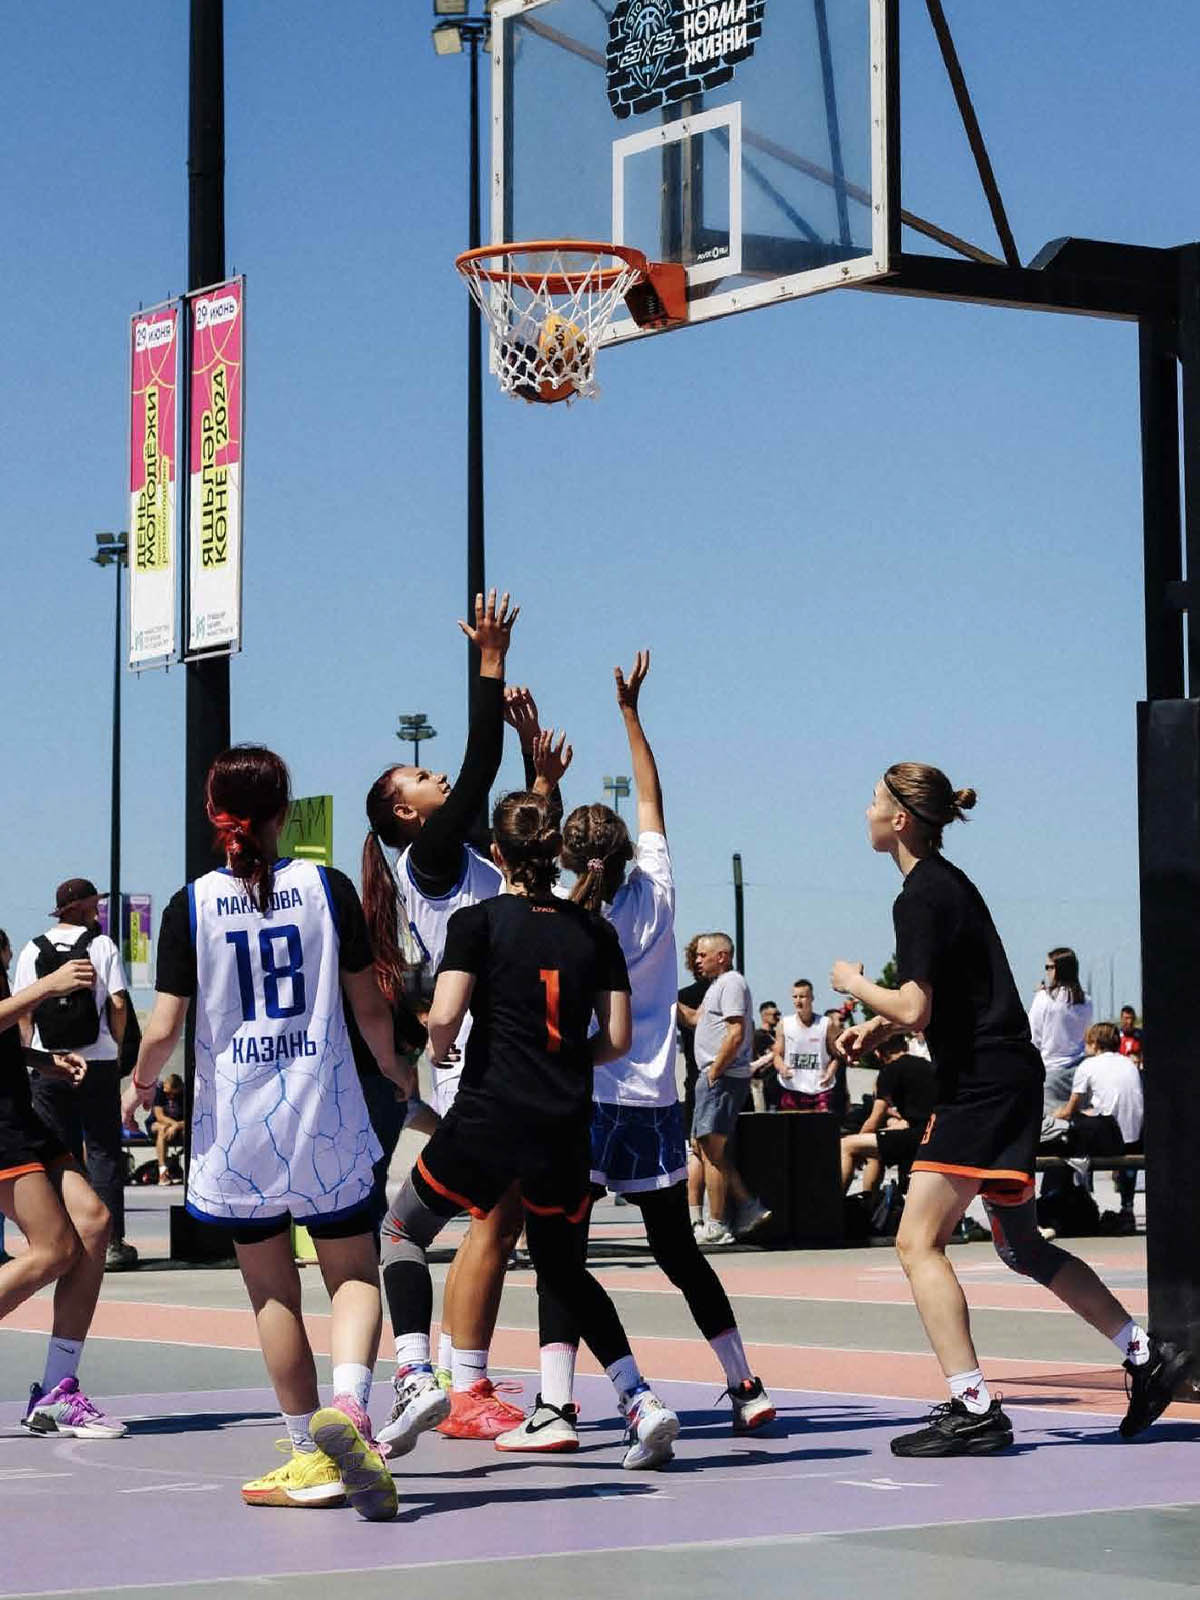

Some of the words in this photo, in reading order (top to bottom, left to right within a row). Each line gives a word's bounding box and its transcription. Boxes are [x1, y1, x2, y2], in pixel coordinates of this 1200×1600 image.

[684, 2, 747, 40] НОРМА
[685, 25, 747, 67] ЖИЗНИ
[197, 305, 208, 325] 29
[137, 327, 147, 347] 29
[213, 370, 228, 444] 2024
[137, 492, 146, 569] ДЕНЬ
[216, 888, 303, 916] МАКАОВА
[225, 924, 306, 1022] 18
[539, 969, 560, 1051] 1
[232, 1030, 317, 1064] КАЗАНЬ
